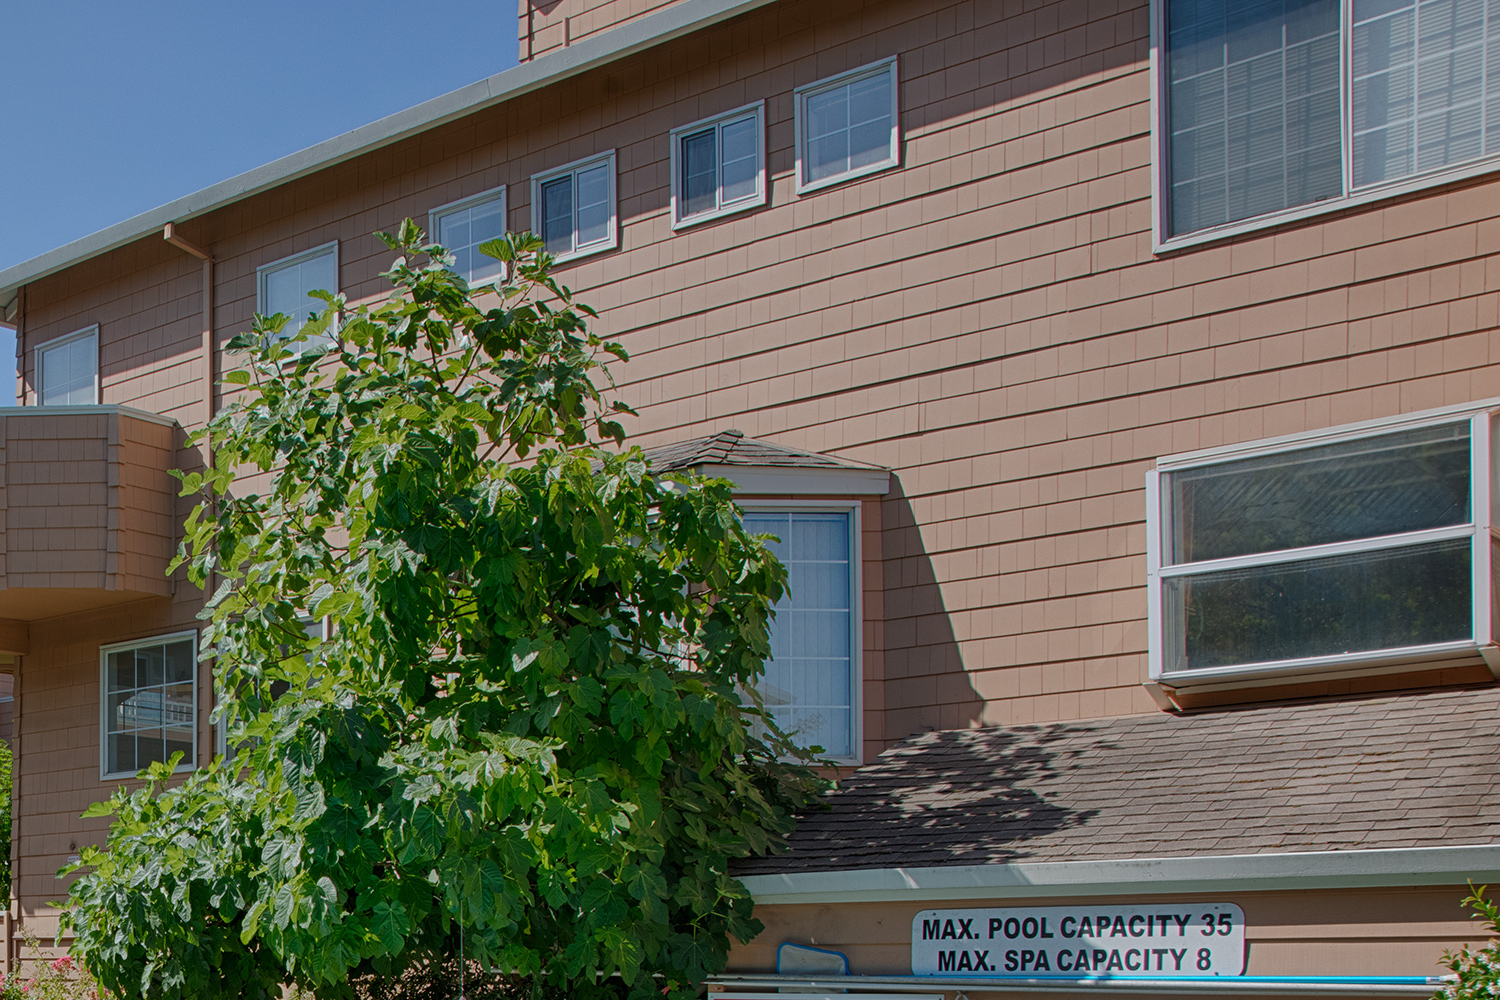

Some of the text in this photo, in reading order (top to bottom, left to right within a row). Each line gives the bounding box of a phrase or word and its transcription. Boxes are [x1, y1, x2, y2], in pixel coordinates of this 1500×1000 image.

[922, 914, 1233, 940] MAX. POOL CAPACITY 35
[938, 948, 1211, 971] MAX. SPA CAPACITY 8
